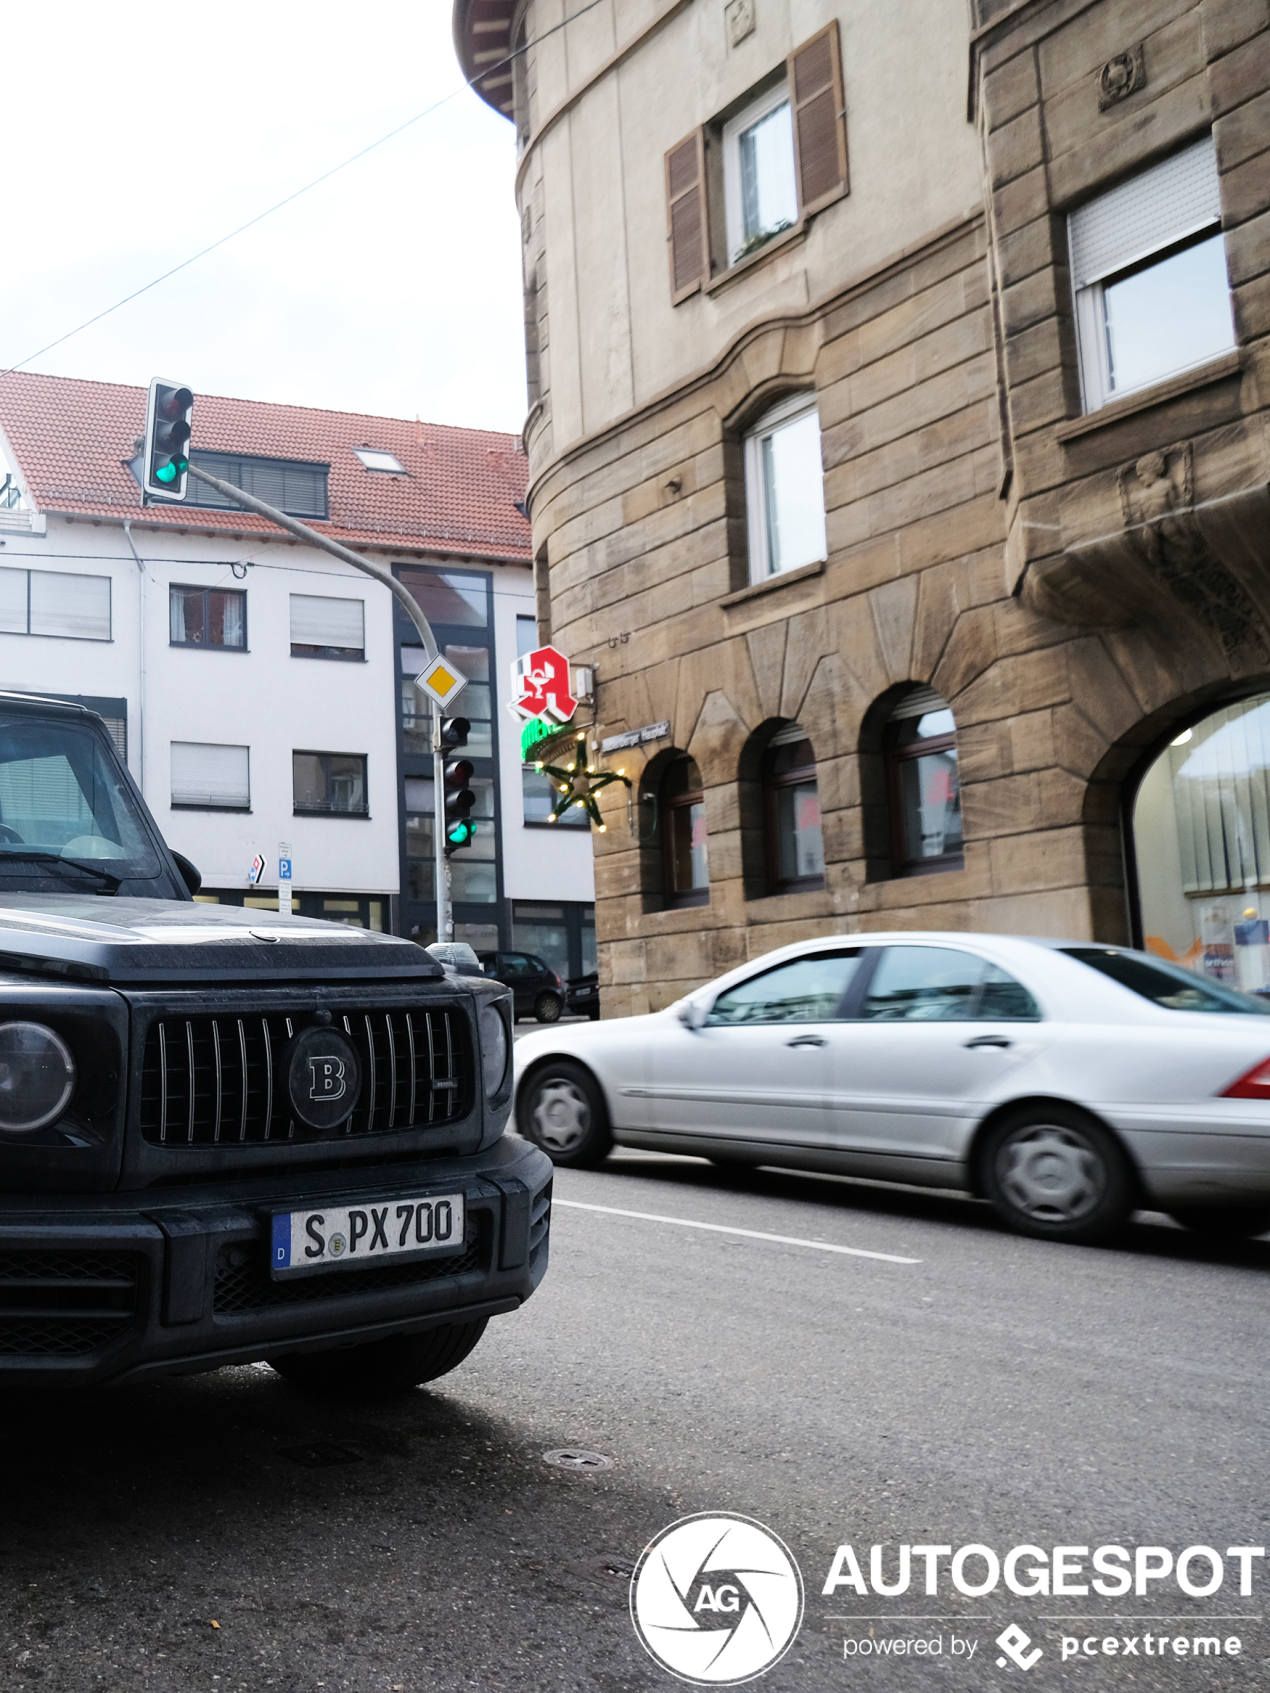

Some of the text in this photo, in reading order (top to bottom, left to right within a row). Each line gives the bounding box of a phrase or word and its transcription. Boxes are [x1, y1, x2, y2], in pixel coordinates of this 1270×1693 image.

[280, 861, 289, 877] P
[309, 1055, 346, 1101] B
[277, 1200, 453, 1260] D S PX 700
